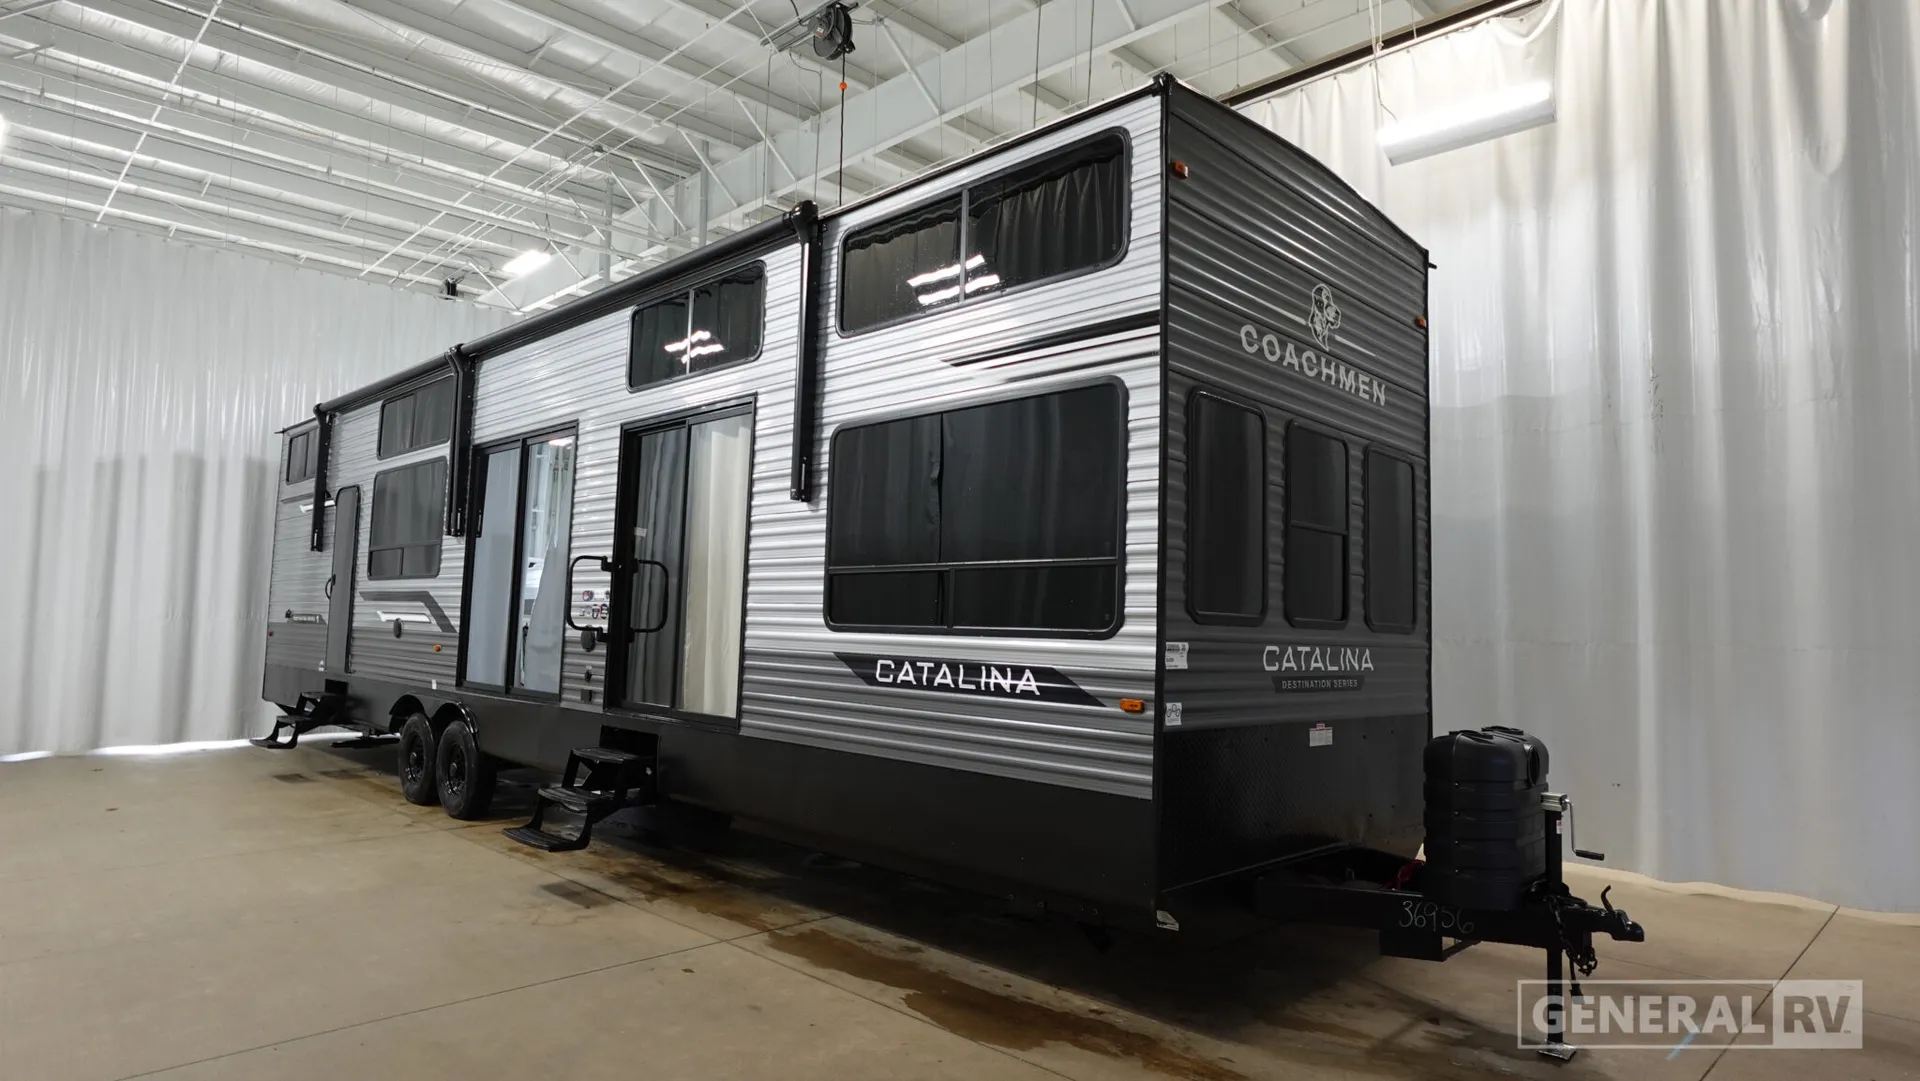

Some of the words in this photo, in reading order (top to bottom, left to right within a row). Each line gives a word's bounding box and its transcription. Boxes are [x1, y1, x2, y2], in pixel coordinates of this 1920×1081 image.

[1240, 324, 1387, 406] COACHMEN
[1263, 645, 1374, 672] CATALINA
[875, 659, 1040, 696] CATALINA
[1281, 679, 1331, 689] DESTINATION
[1333, 678, 1358, 688] SERIES
[1398, 900, 1475, 934] 36956
